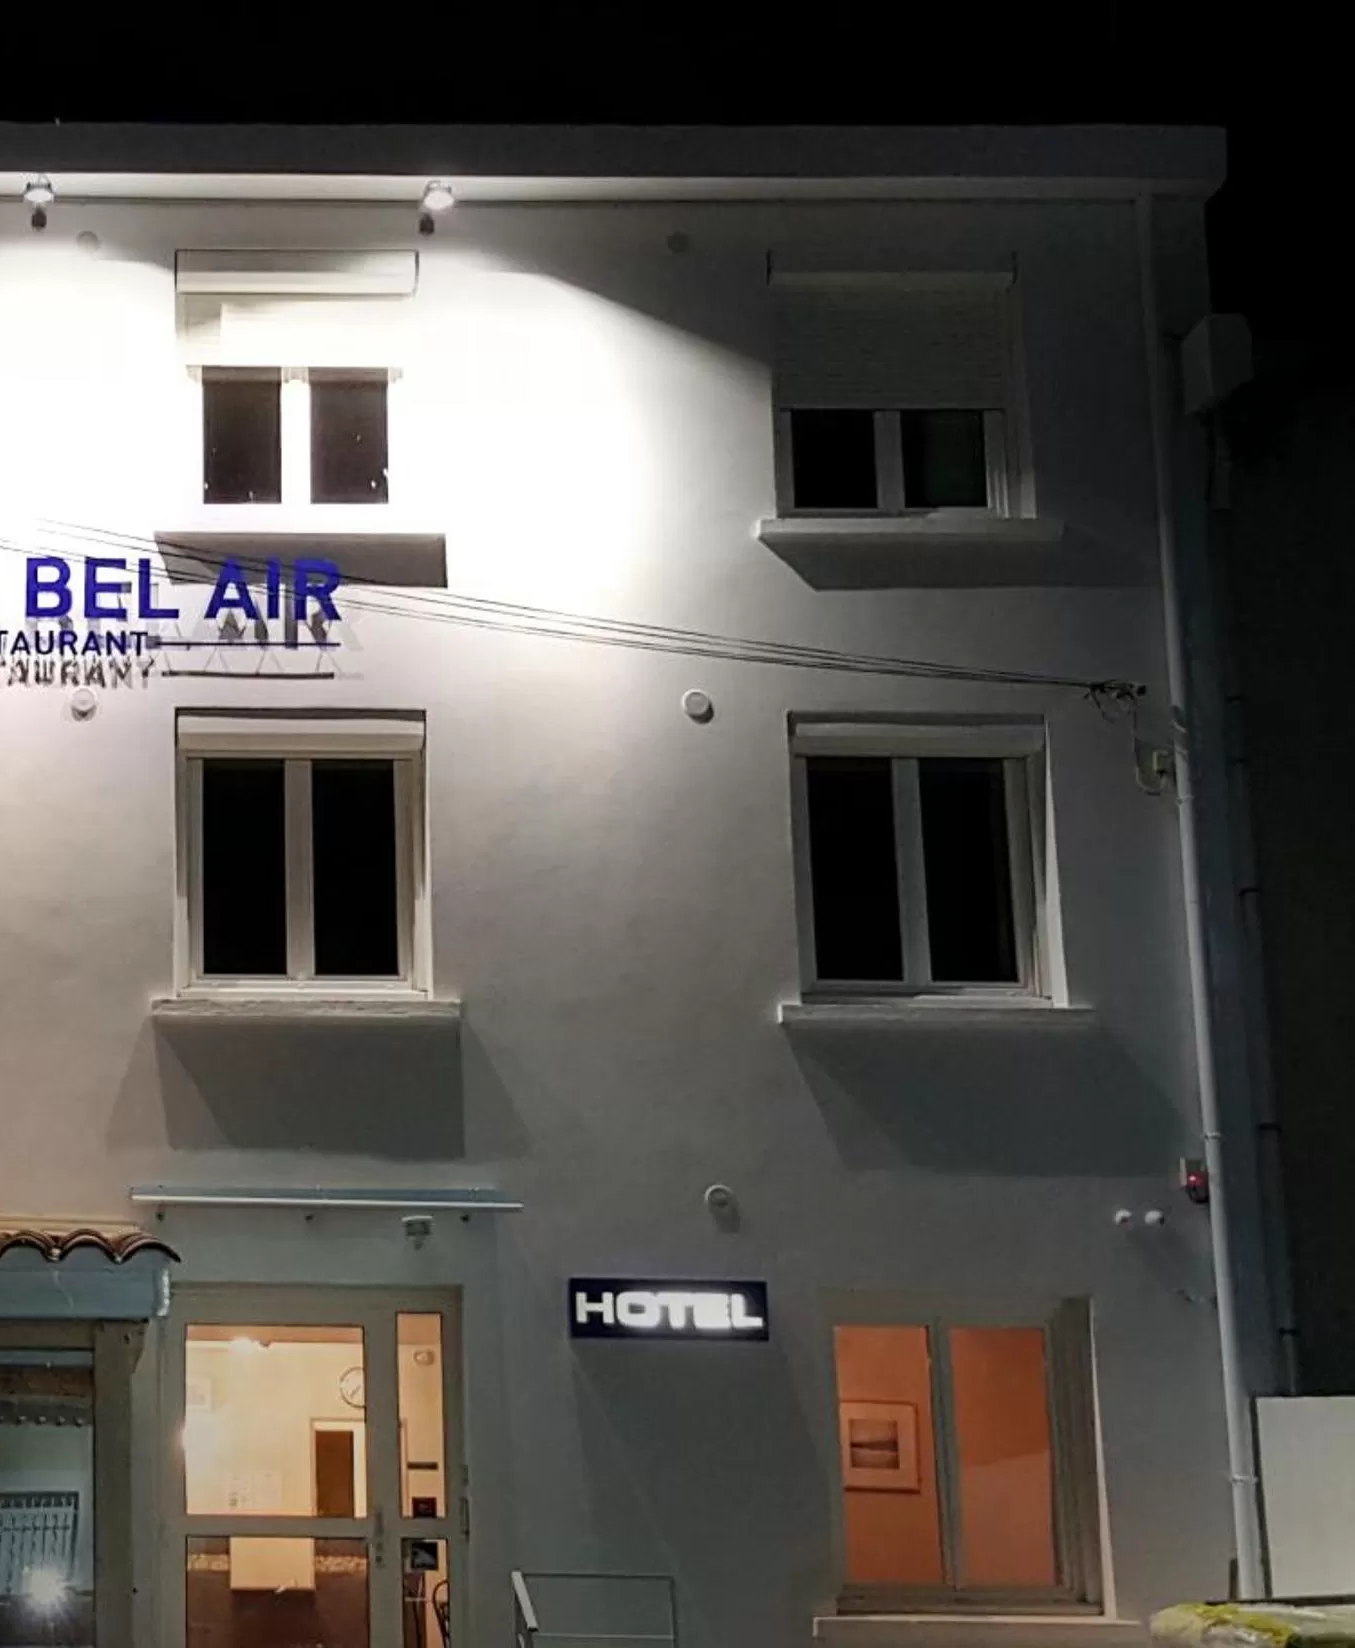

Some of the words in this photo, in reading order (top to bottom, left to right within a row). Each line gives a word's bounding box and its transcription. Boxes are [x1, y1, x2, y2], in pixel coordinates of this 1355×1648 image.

[26, 556, 179, 619] BEL
[205, 555, 342, 621] AIR
[575, 1291, 763, 1329] HOTEL
